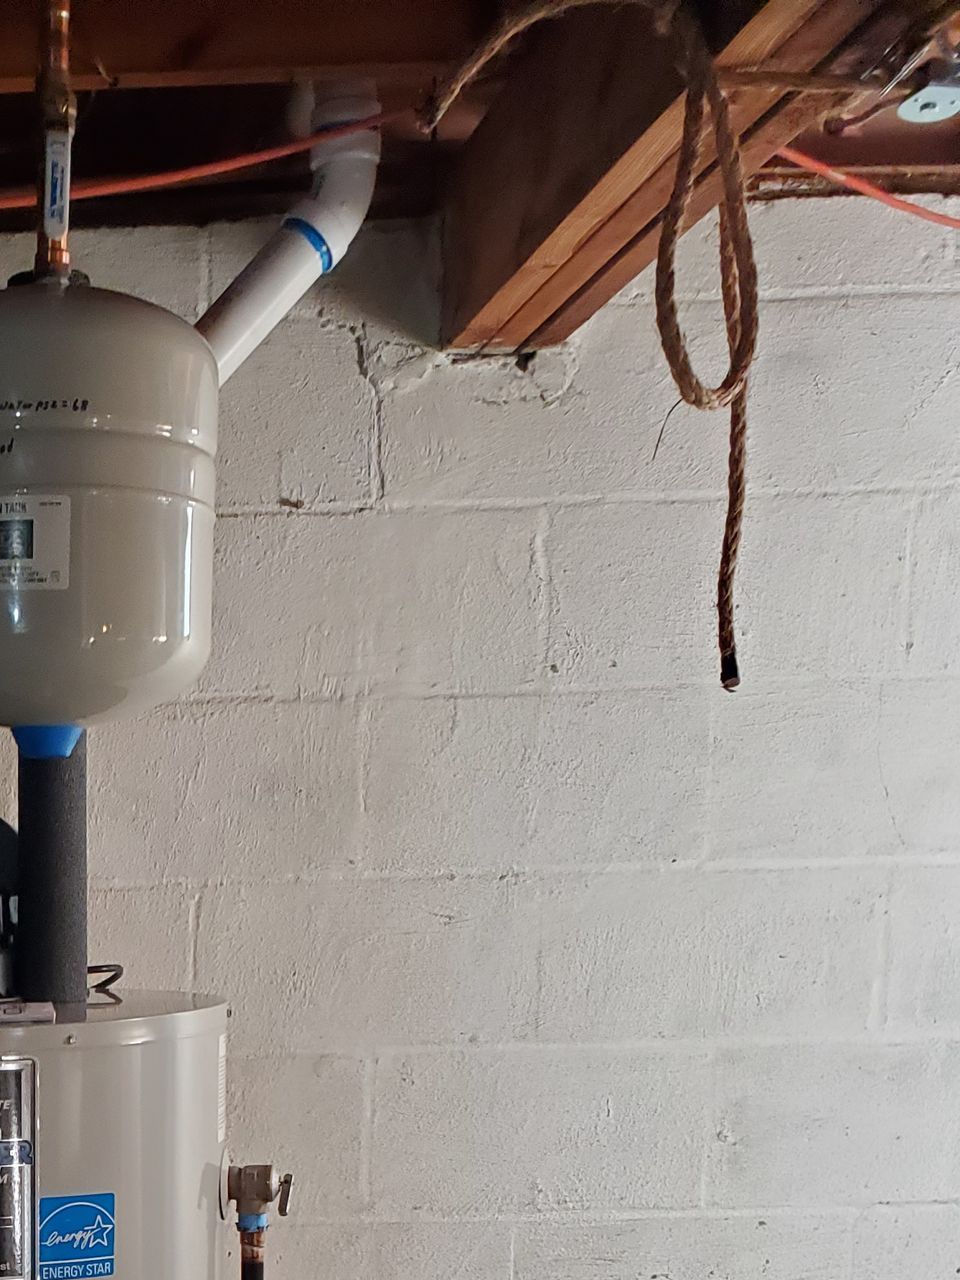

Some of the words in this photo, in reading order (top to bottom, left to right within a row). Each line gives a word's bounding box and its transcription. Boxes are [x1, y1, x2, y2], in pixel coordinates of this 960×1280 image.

[5, 501, 27, 514] TANK
[42, 1266, 85, 1280] ENERGY
[86, 1261, 111, 1277] STAR
